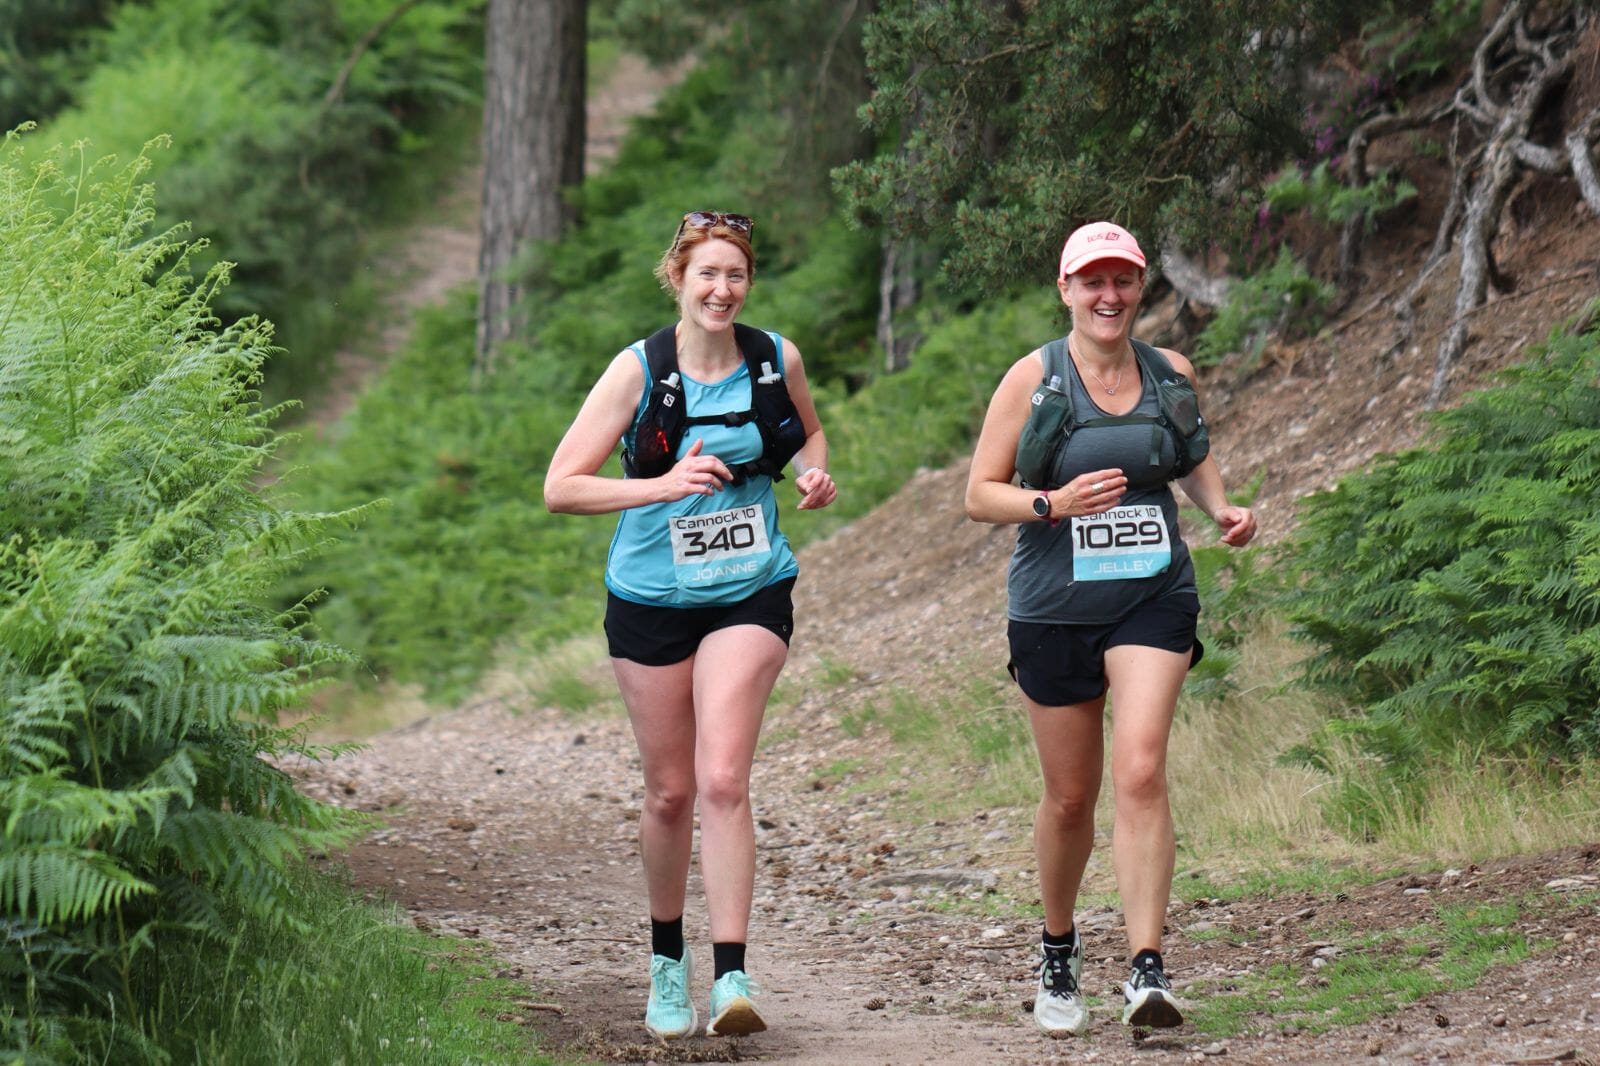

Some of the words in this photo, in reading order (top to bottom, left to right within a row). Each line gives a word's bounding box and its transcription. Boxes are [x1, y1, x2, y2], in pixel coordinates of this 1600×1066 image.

[677, 512, 740, 530] Cannock
[742, 508, 756, 519] 10
[1145, 507, 1157, 518] 10
[682, 523, 755, 557] 340
[1075, 521, 1163, 549] 1029
[693, 561, 758, 581] JOANNE
[1095, 559, 1154, 574] JELLEY
